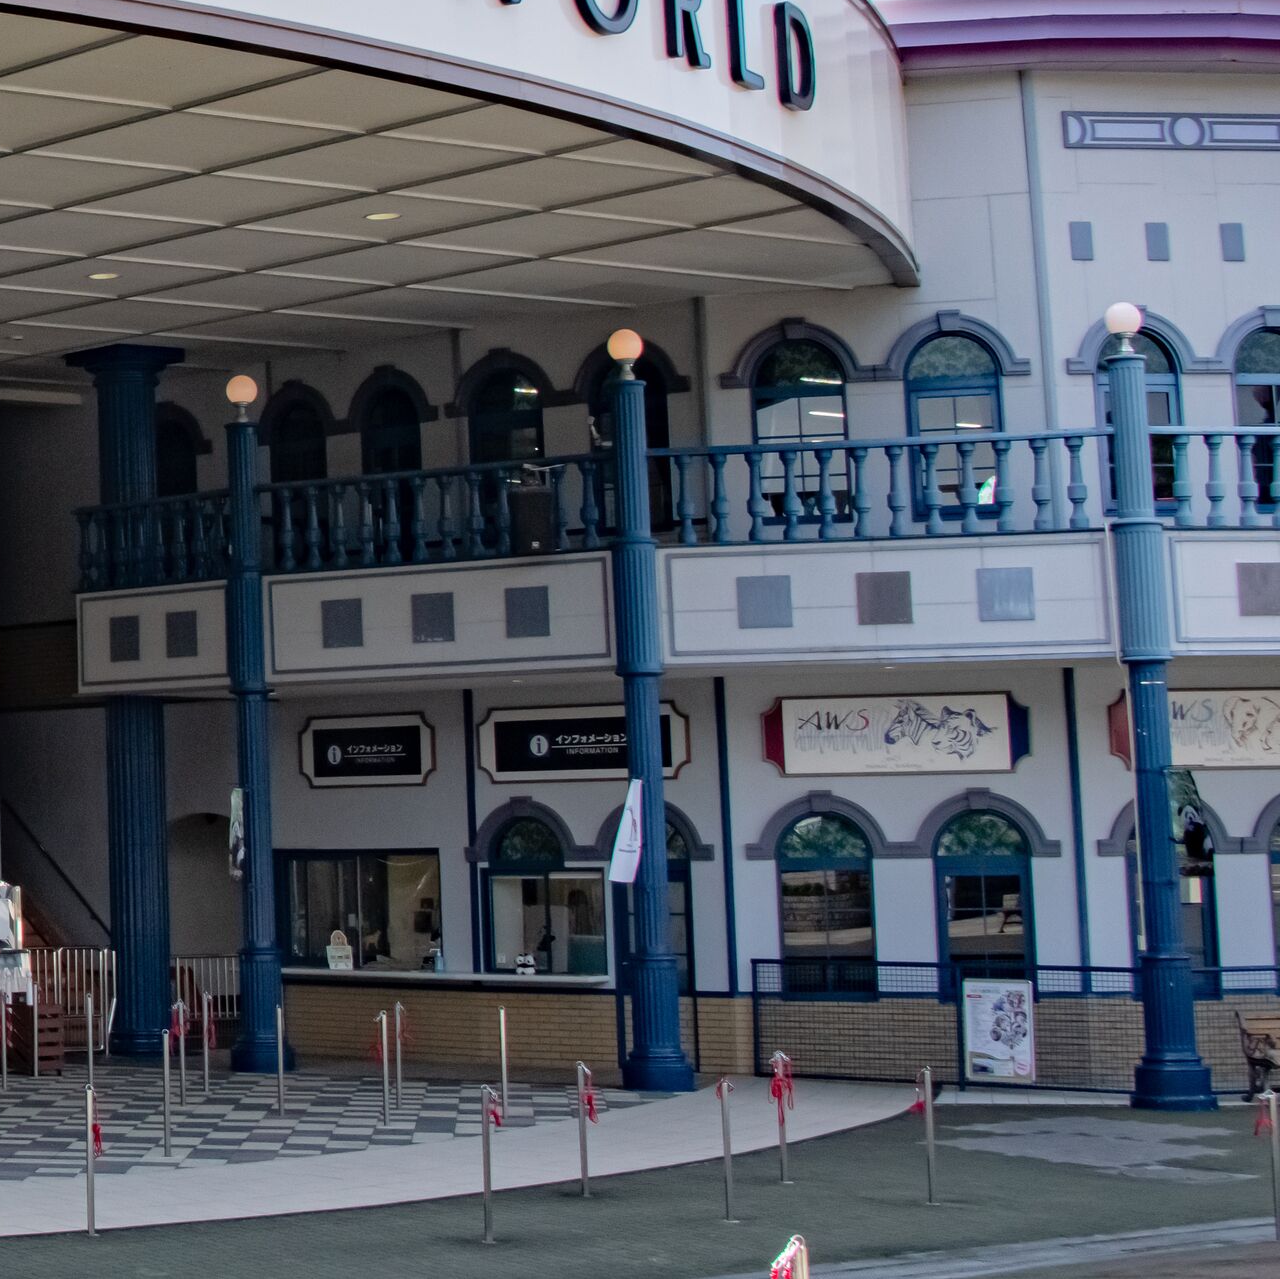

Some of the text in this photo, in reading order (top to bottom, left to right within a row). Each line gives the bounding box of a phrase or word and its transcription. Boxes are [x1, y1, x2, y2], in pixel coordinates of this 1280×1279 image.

[1171, 698, 1214, 723] WS
[346, 744, 403, 754] インフォメーション
[566, 746, 619, 755] INFORMATION
